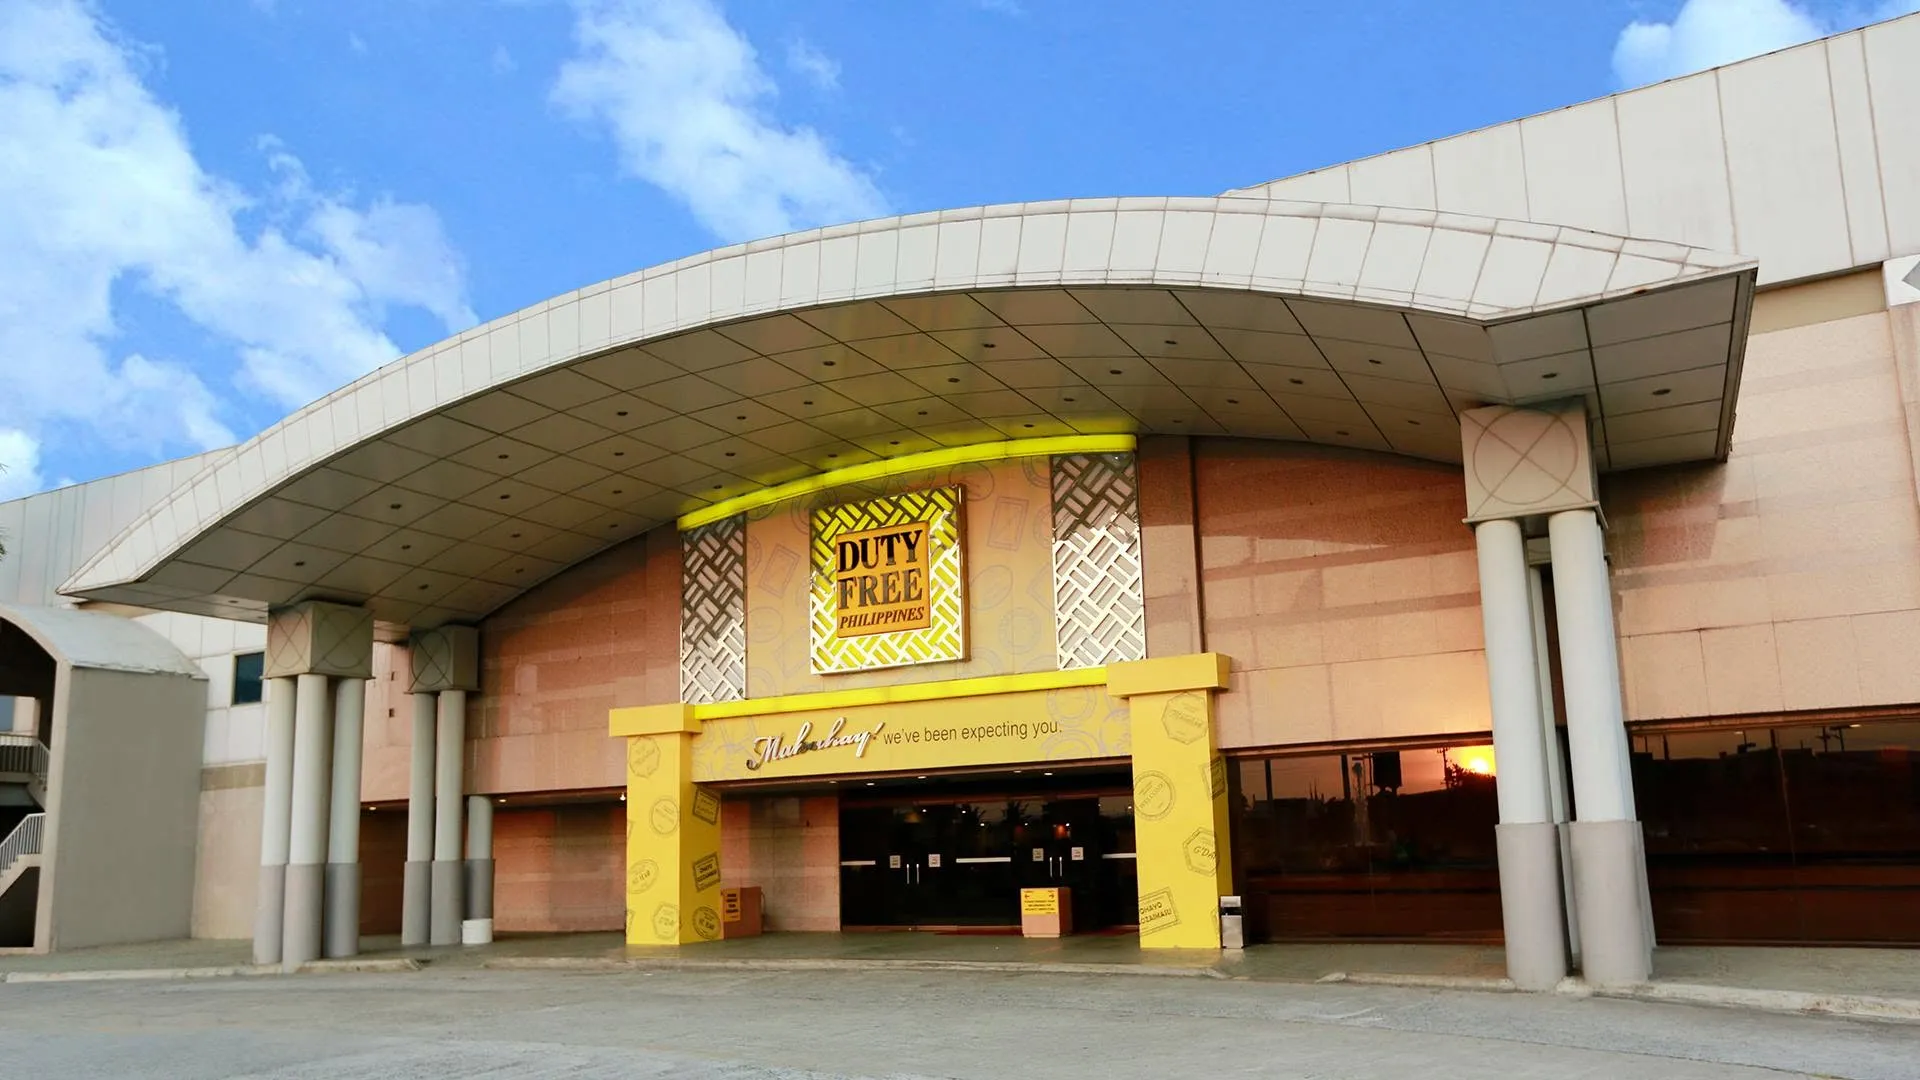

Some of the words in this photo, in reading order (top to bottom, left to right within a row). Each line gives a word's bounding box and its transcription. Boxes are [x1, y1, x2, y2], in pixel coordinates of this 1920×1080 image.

[838, 529, 923, 573] DUTY
[838, 567, 923, 610] FREE
[840, 606, 924, 629] PHILIPPINES
[884, 728, 920, 745] we've
[924, 727, 957, 742] been
[961, 720, 1028, 742] expecting
[1032, 720, 1062, 738] you.
